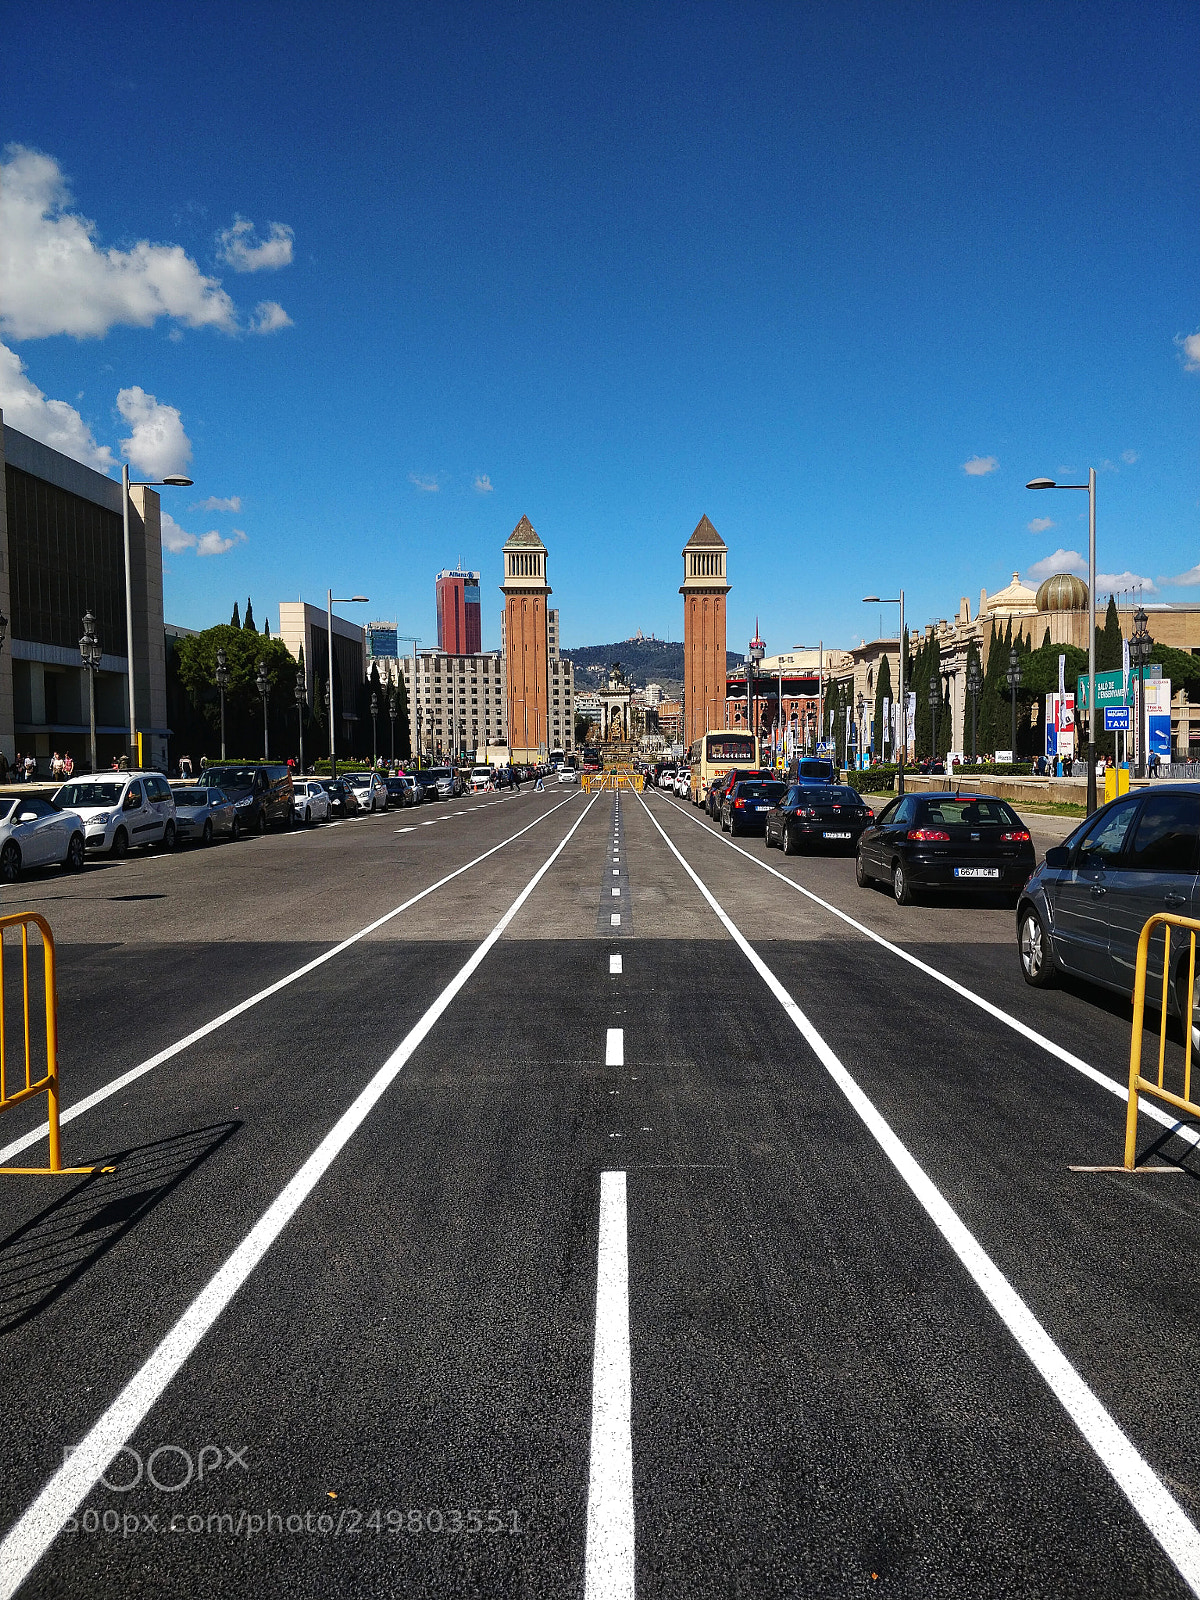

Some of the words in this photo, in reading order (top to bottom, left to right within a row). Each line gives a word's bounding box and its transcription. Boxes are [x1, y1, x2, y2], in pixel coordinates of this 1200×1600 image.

[1108, 681, 1115, 689] DE
[1097, 688, 1129, 699] L'ENSENYAMET
[960, 868, 979, 876] 6671
